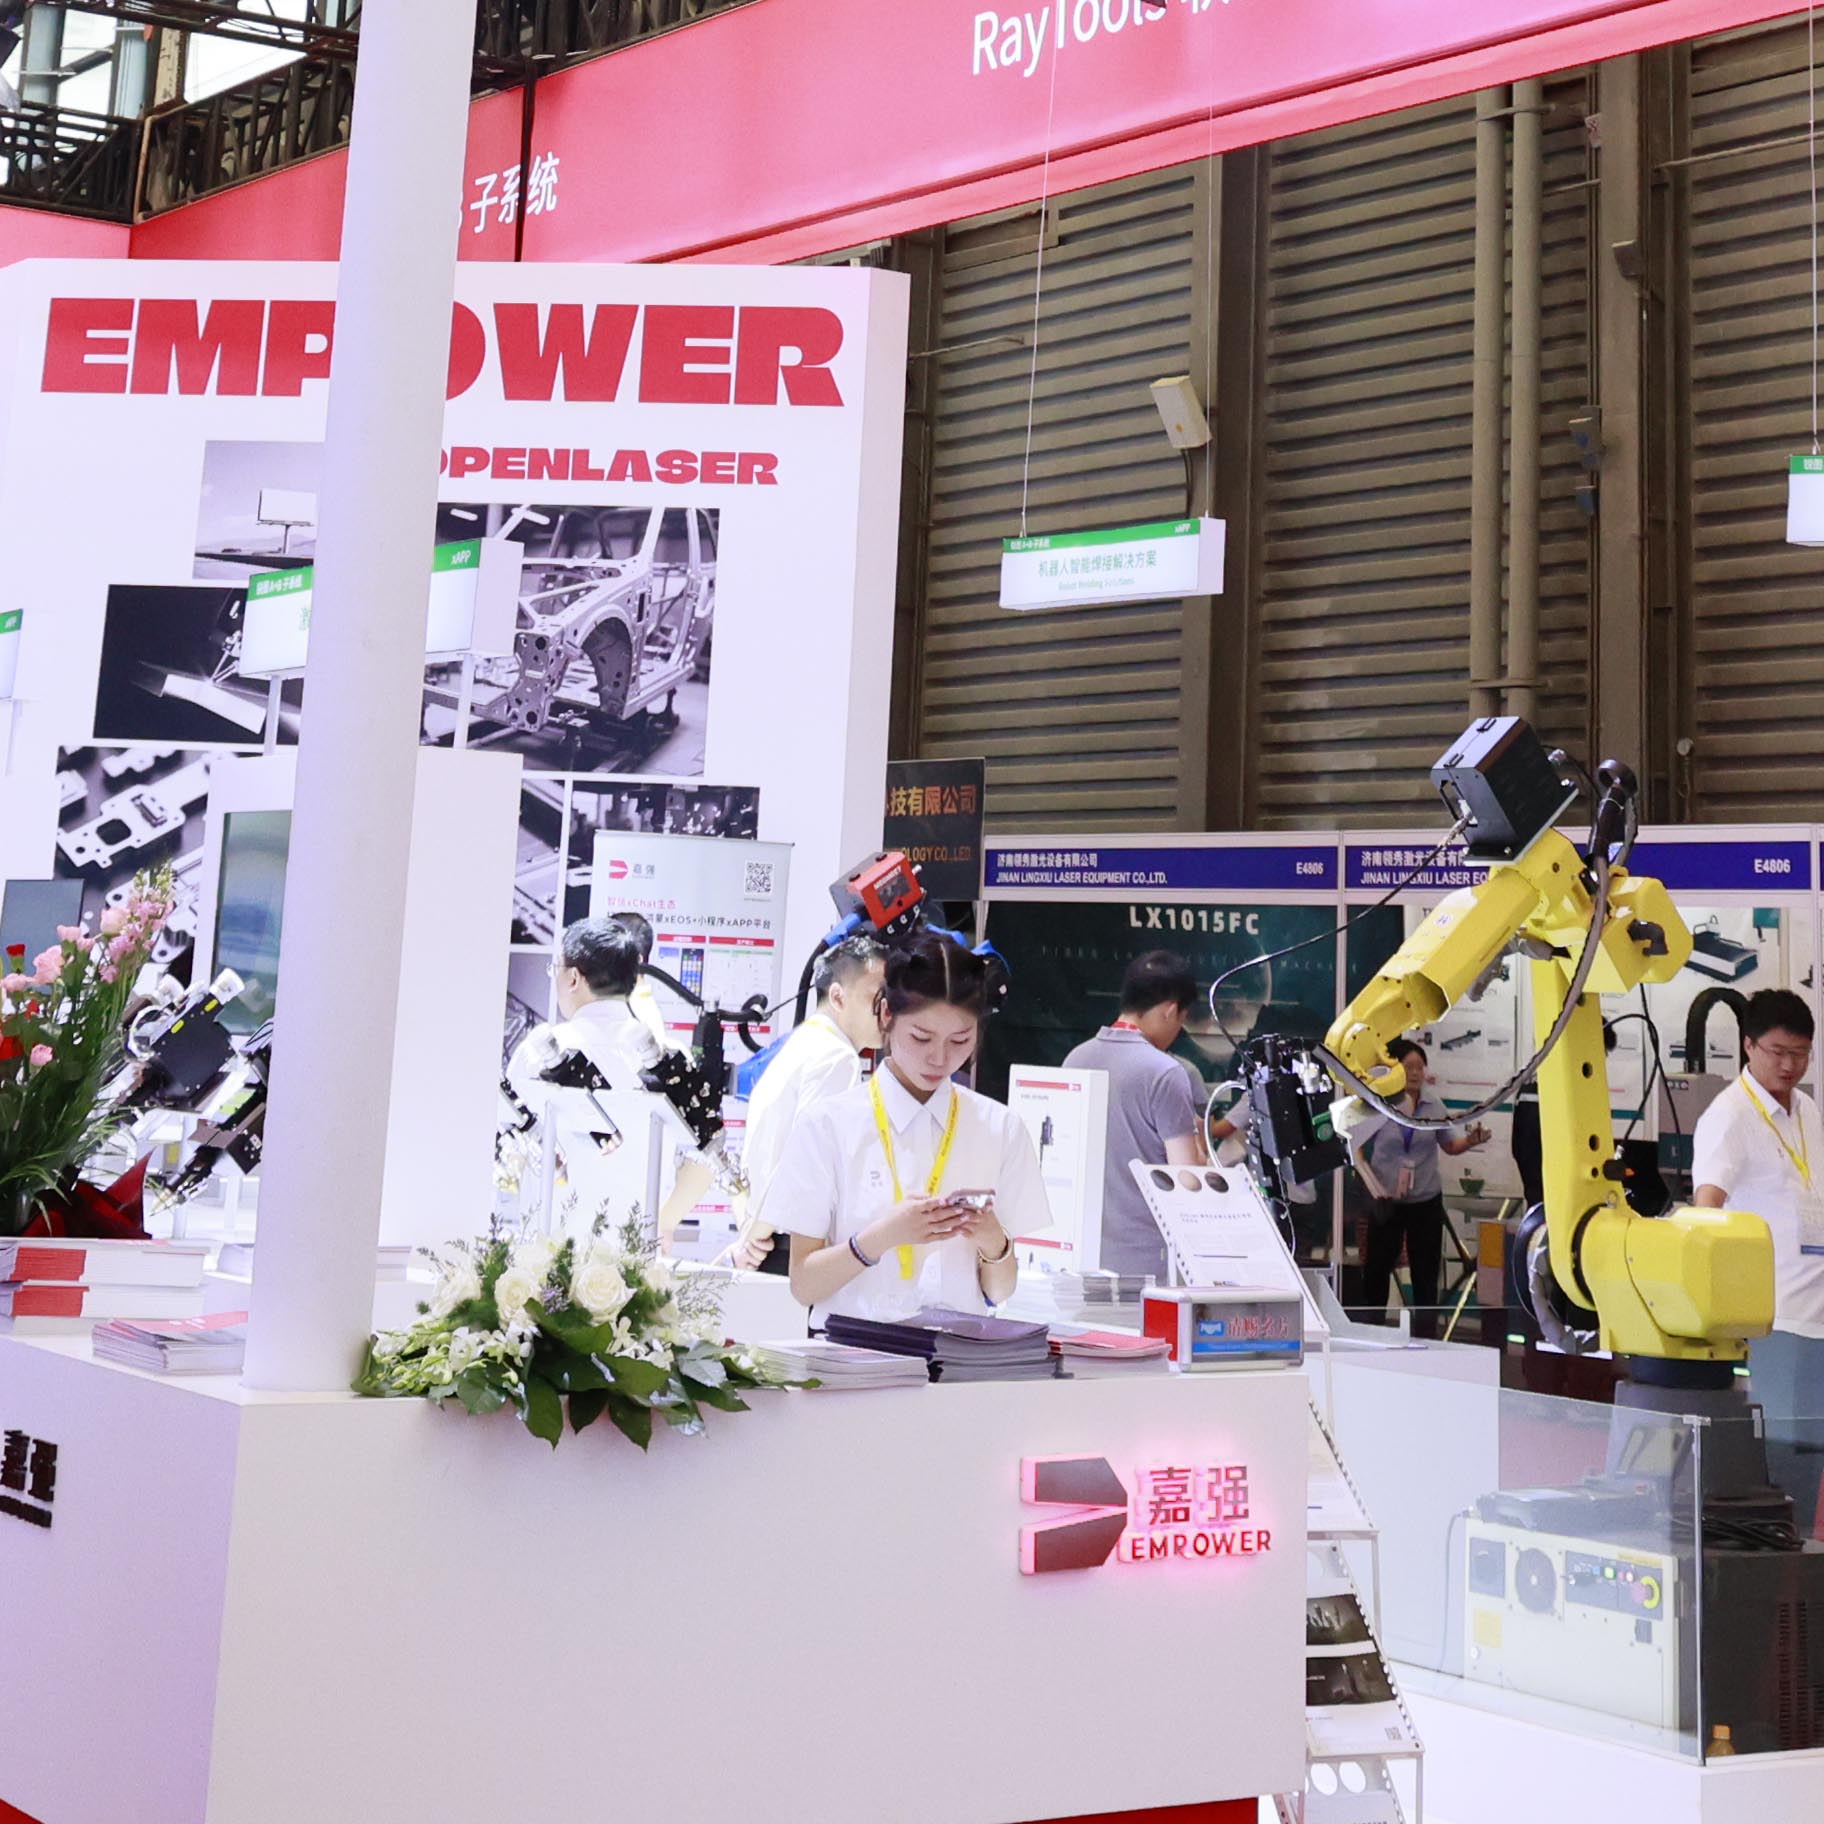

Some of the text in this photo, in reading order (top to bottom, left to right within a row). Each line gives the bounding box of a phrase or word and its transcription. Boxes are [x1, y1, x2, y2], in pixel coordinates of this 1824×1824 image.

[885, 784, 976, 817] 技有限公司
[1054, 872, 1080, 883] LASER
[1082, 872, 1131, 884] EQUIPMENT
[1361, 871, 1390, 885] JINAN
[1436, 871, 1471, 884] LASER
[1754, 858, 1791, 875] E4806
[1129, 905, 1260, 935] LX1015FC
[1148, 1465, 1250, 1526] 嘉强
[1131, 1529, 1272, 1560] EMPOWER
